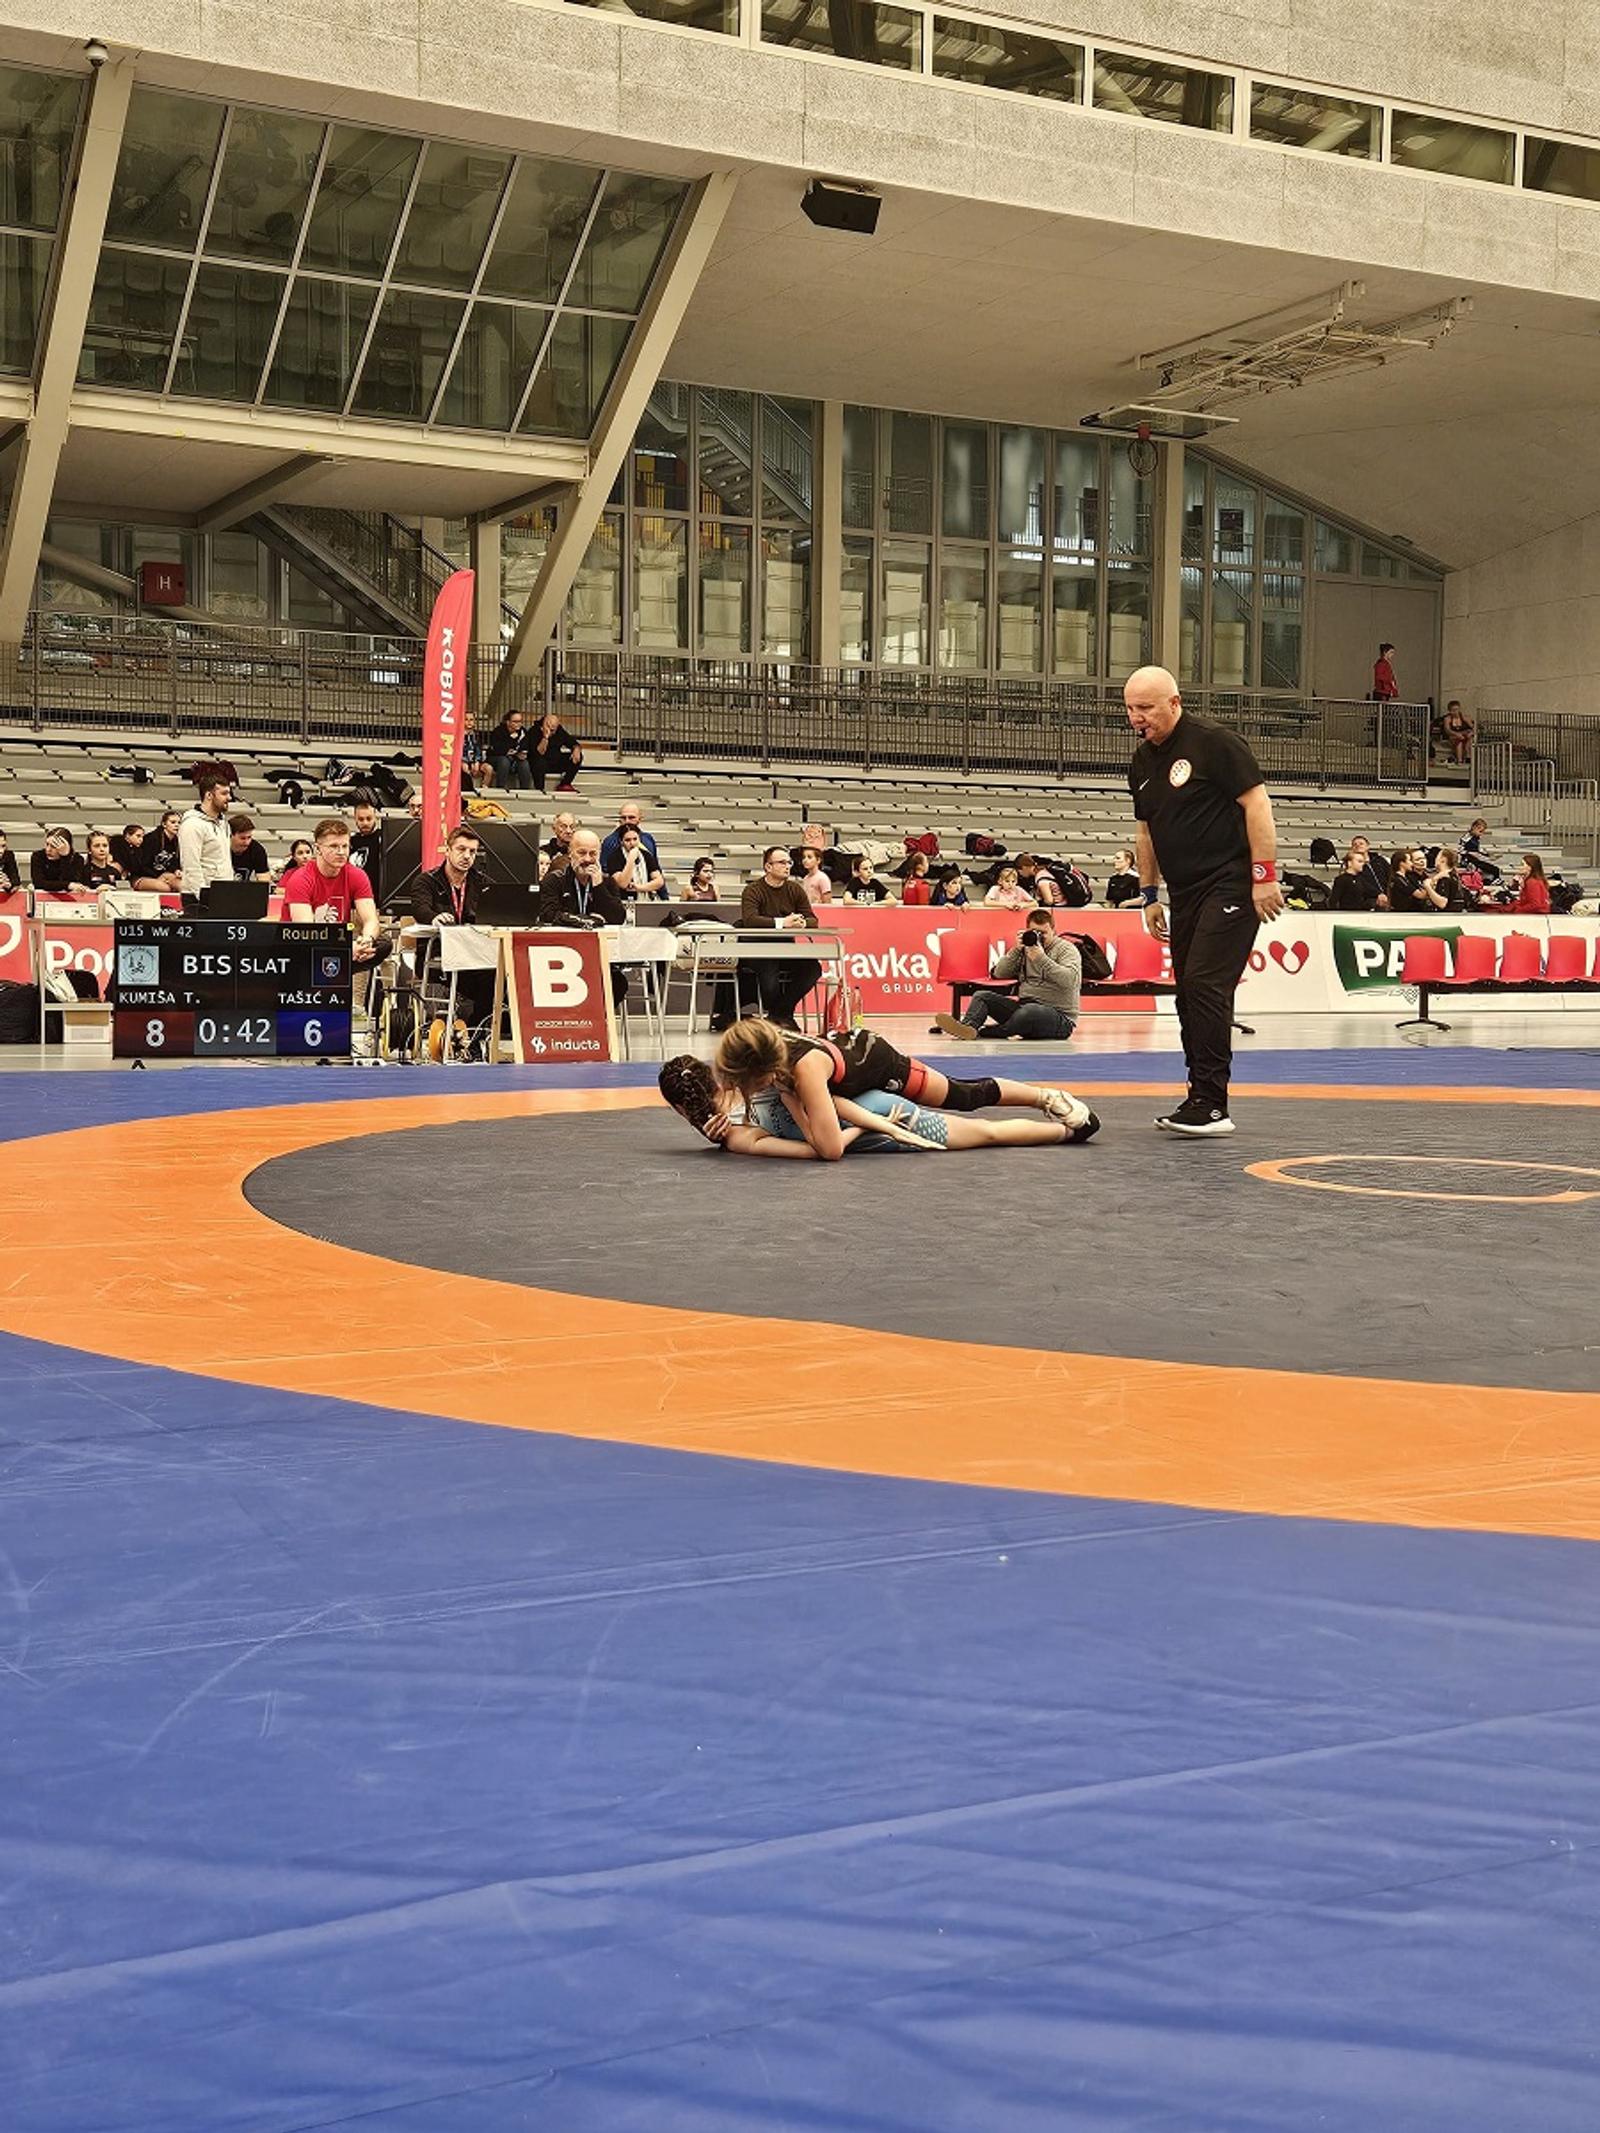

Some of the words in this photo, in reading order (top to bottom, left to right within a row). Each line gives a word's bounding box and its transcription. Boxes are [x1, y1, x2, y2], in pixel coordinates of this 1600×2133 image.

[119, 925, 144, 937] U15
[176, 926, 193, 938] 42
[227, 926, 247, 941] 59
[282, 928, 328, 940] Round
[183, 955, 232, 974] BIS
[240, 958, 290, 974] SLAT
[527, 945, 588, 1007] B
[881, 983, 934, 993] GRUPA
[119, 990, 176, 1004] KUMIŠA
[183, 992, 201, 1004] T.
[278, 991, 322, 1004] TAŠIĆ
[329, 993, 345, 1004] A.
[145, 1019, 165, 1047] 8
[199, 1018, 270, 1043] 0:42
[304, 1019, 323, 1047] 6
[551, 1038, 600, 1050] inducta
